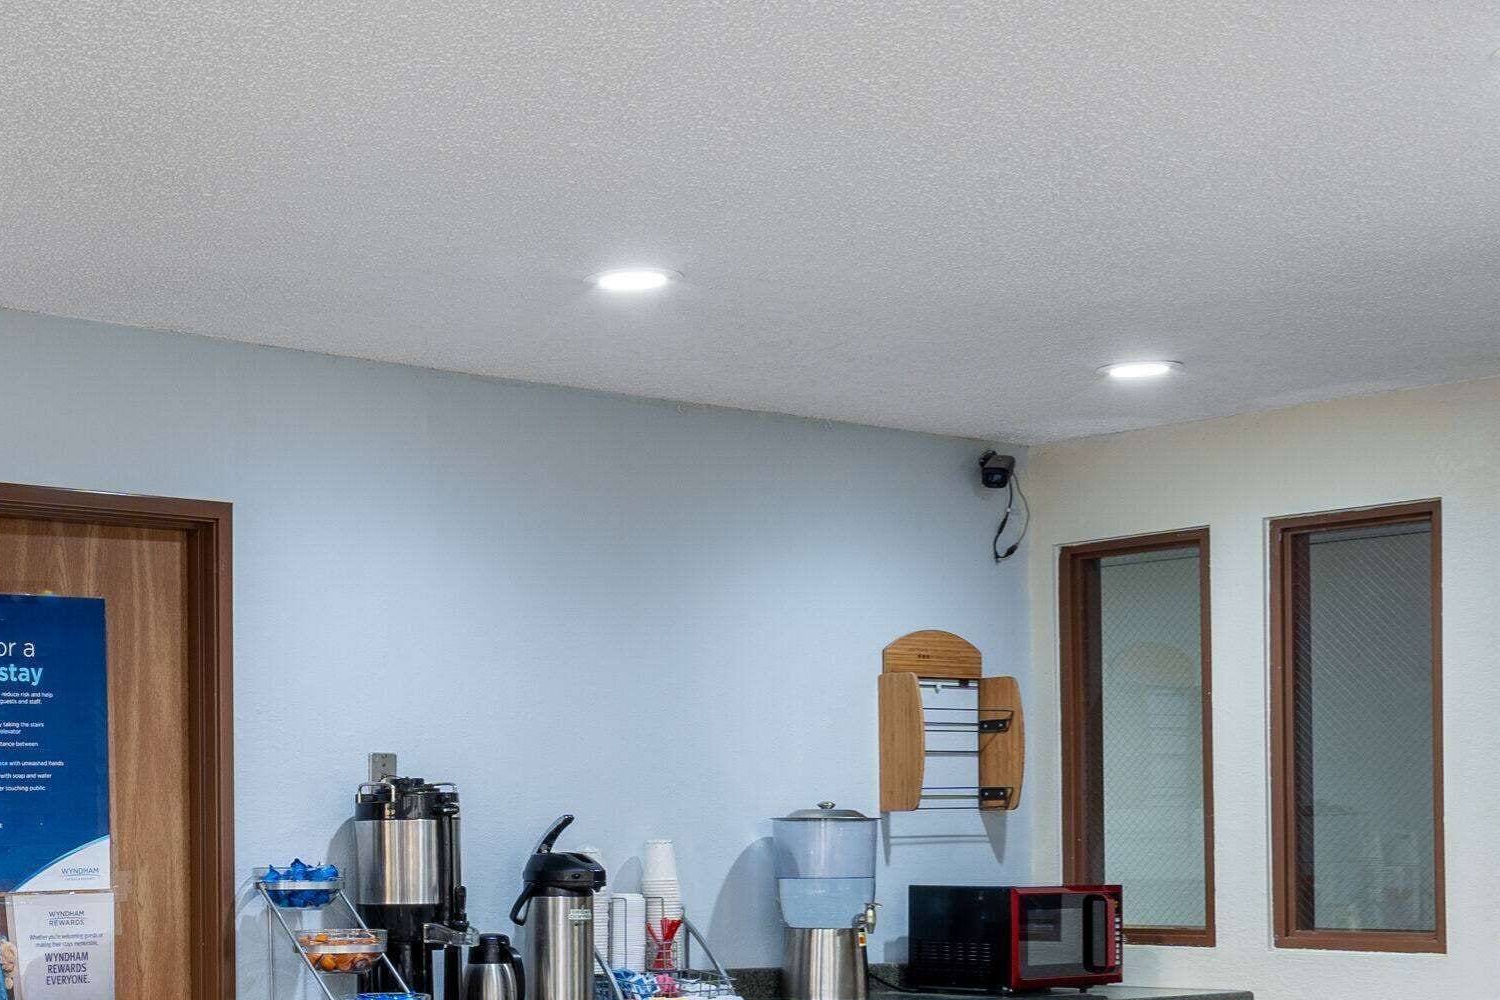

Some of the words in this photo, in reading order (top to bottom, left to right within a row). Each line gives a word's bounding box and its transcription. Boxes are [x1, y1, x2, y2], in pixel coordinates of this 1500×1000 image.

[24, 642, 35, 657] a
[45, 952, 89, 962] WYNDHAM
[48, 963, 86, 973] REWARDS
[46, 975, 90, 985] EVERYONE.
